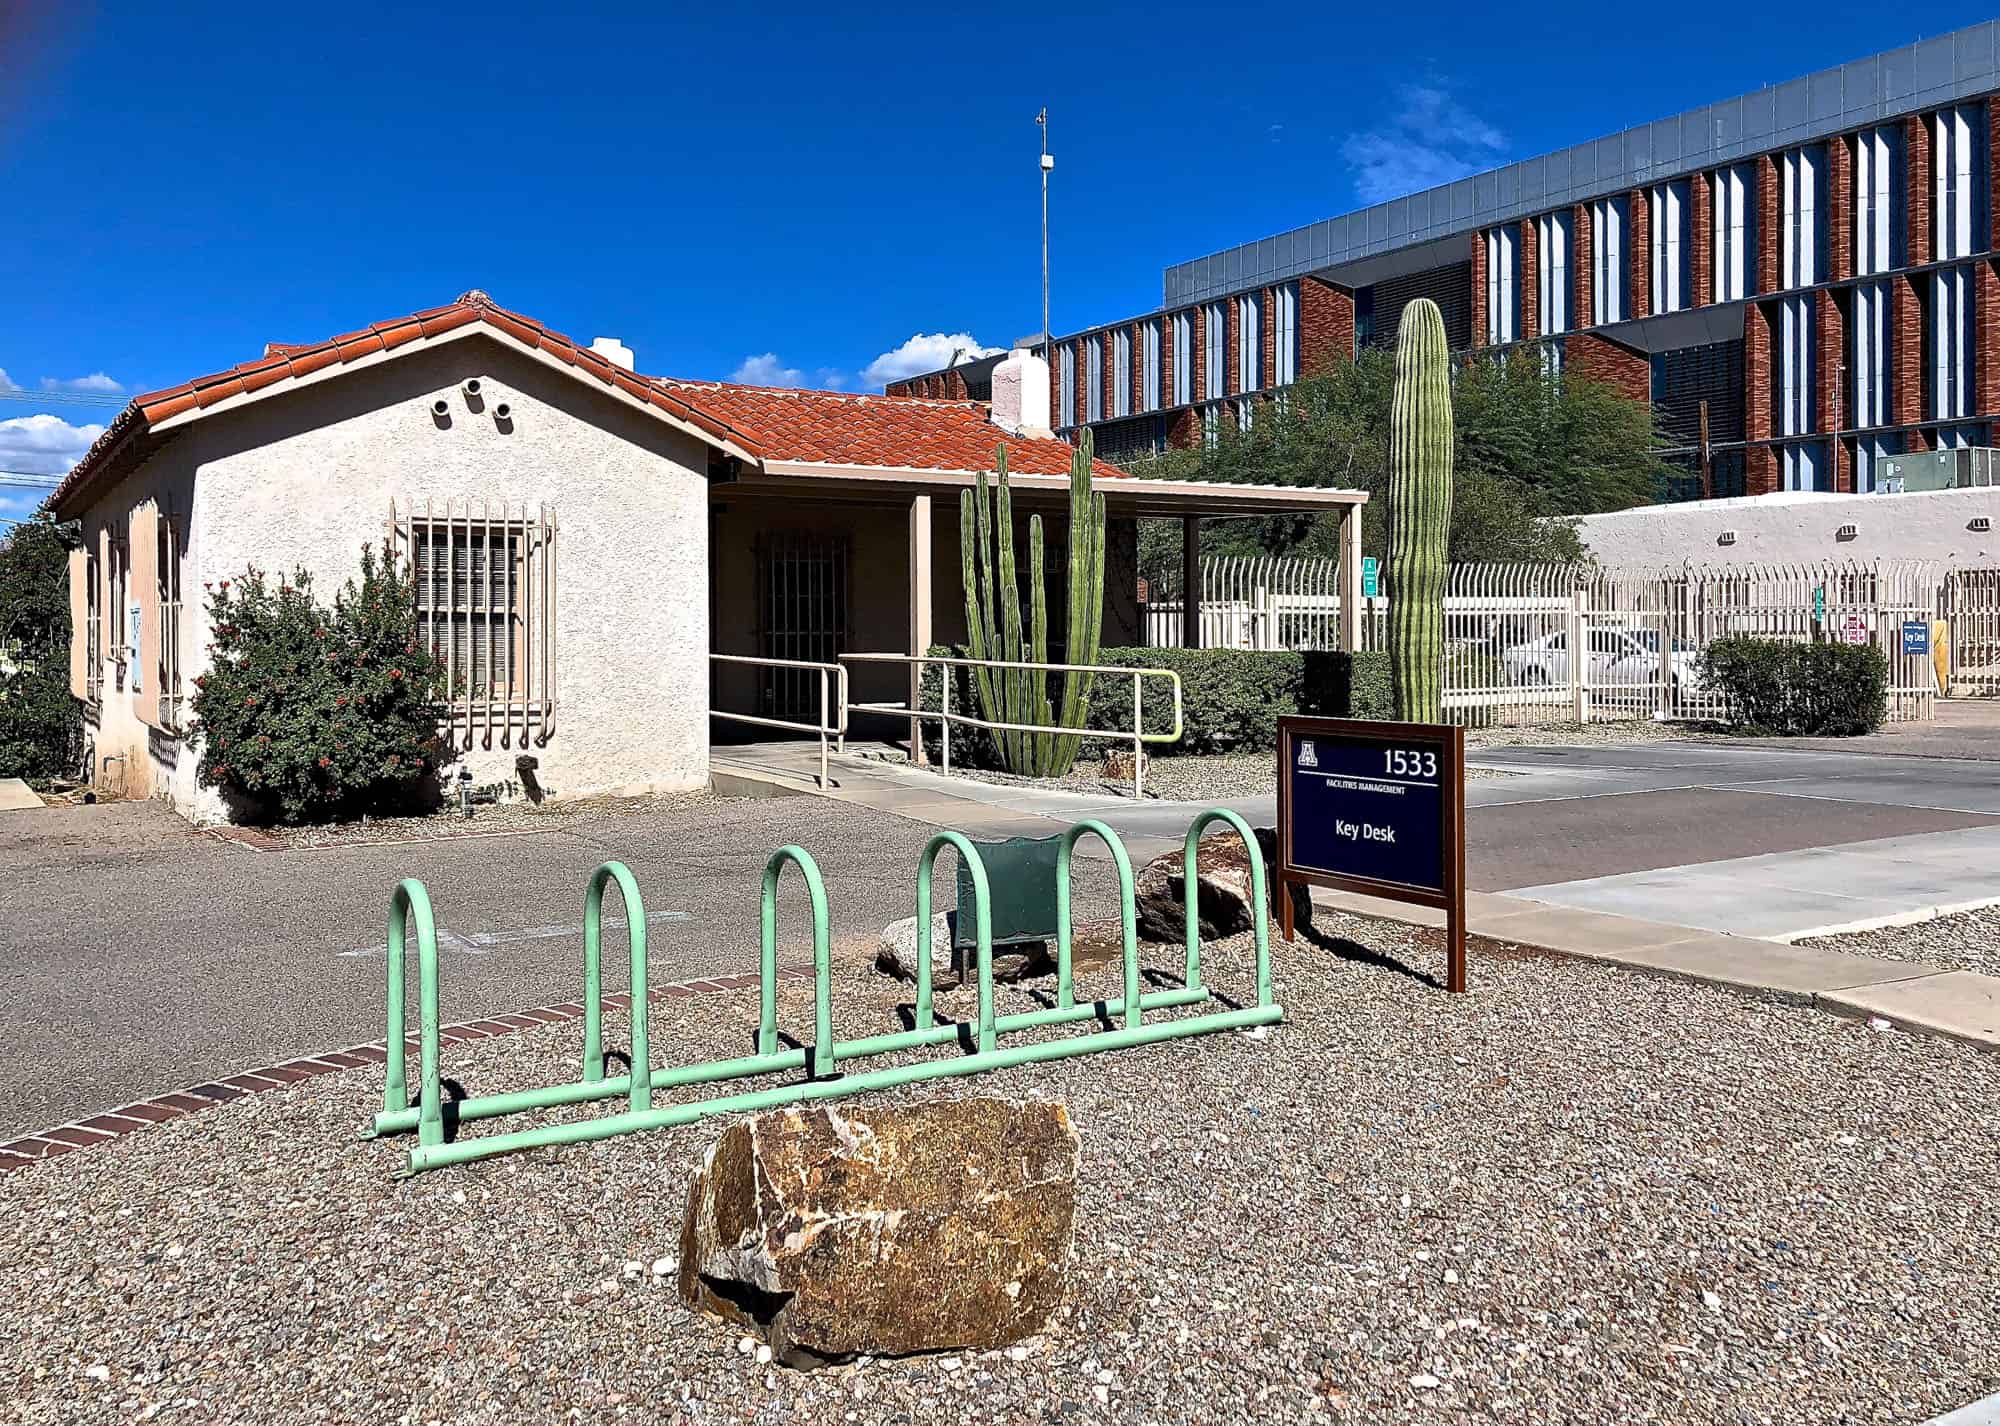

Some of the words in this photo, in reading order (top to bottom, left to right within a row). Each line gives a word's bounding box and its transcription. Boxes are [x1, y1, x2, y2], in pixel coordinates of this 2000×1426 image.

[1384, 749, 1438, 777] 1533
[1326, 778, 1358, 790] FACILITIES
[1358, 782, 1406, 795] MANAGEMENT
[1335, 819, 1359, 841] Key
[1363, 823, 1396, 843] Desk
